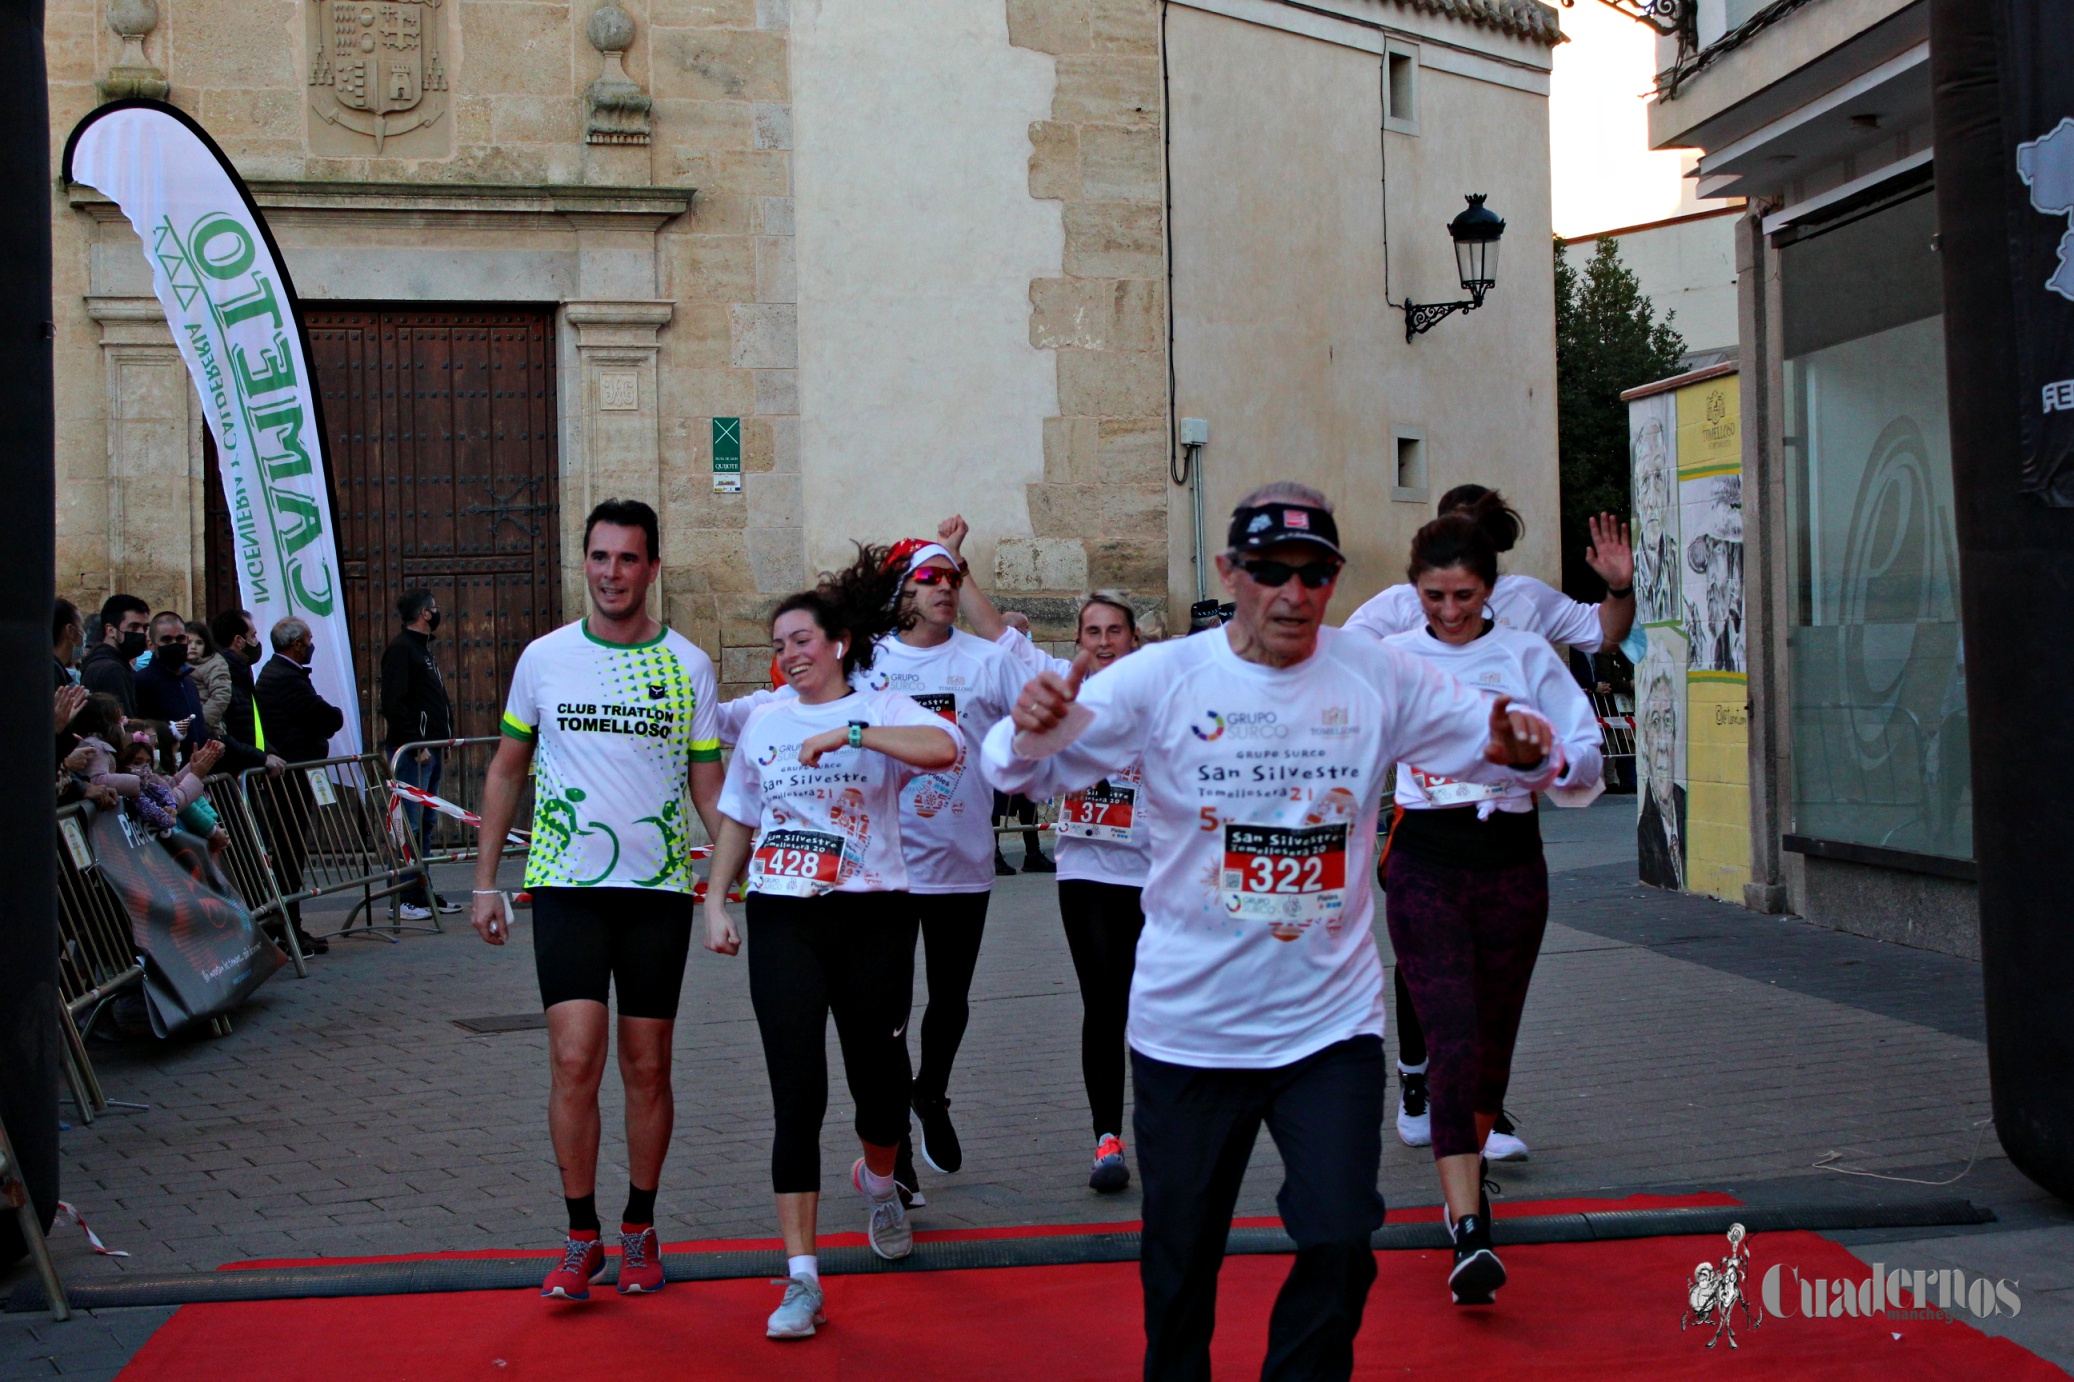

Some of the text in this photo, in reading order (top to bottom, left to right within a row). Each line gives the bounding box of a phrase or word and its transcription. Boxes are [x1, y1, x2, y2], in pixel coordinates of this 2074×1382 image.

[891, 673, 919, 681] GRUPO
[890, 682, 925, 691] SURCO
[557, 703, 674, 723] CLUB TRIATLON
[1227, 711, 1277, 725] GRUPO
[557, 717, 672, 739] TOMELLOSO
[1227, 725, 1289, 739] SURCO
[779, 743, 803, 753] GRUP
[1236, 749, 1326, 759] GRUPO SURCO
[777, 751, 799, 762] SUR
[1198, 765, 1360, 782] San Silvestre
[763, 772, 868, 793] San Silvestre
[817, 789, 833, 799] 21
[1290, 787, 1312, 801] 21
[1080, 801, 1110, 824] 37
[784, 834, 837, 848] Silvestre
[1232, 831, 1339, 846] San Silvestre
[769, 849, 820, 878] 428
[1249, 856, 1323, 892] 322
